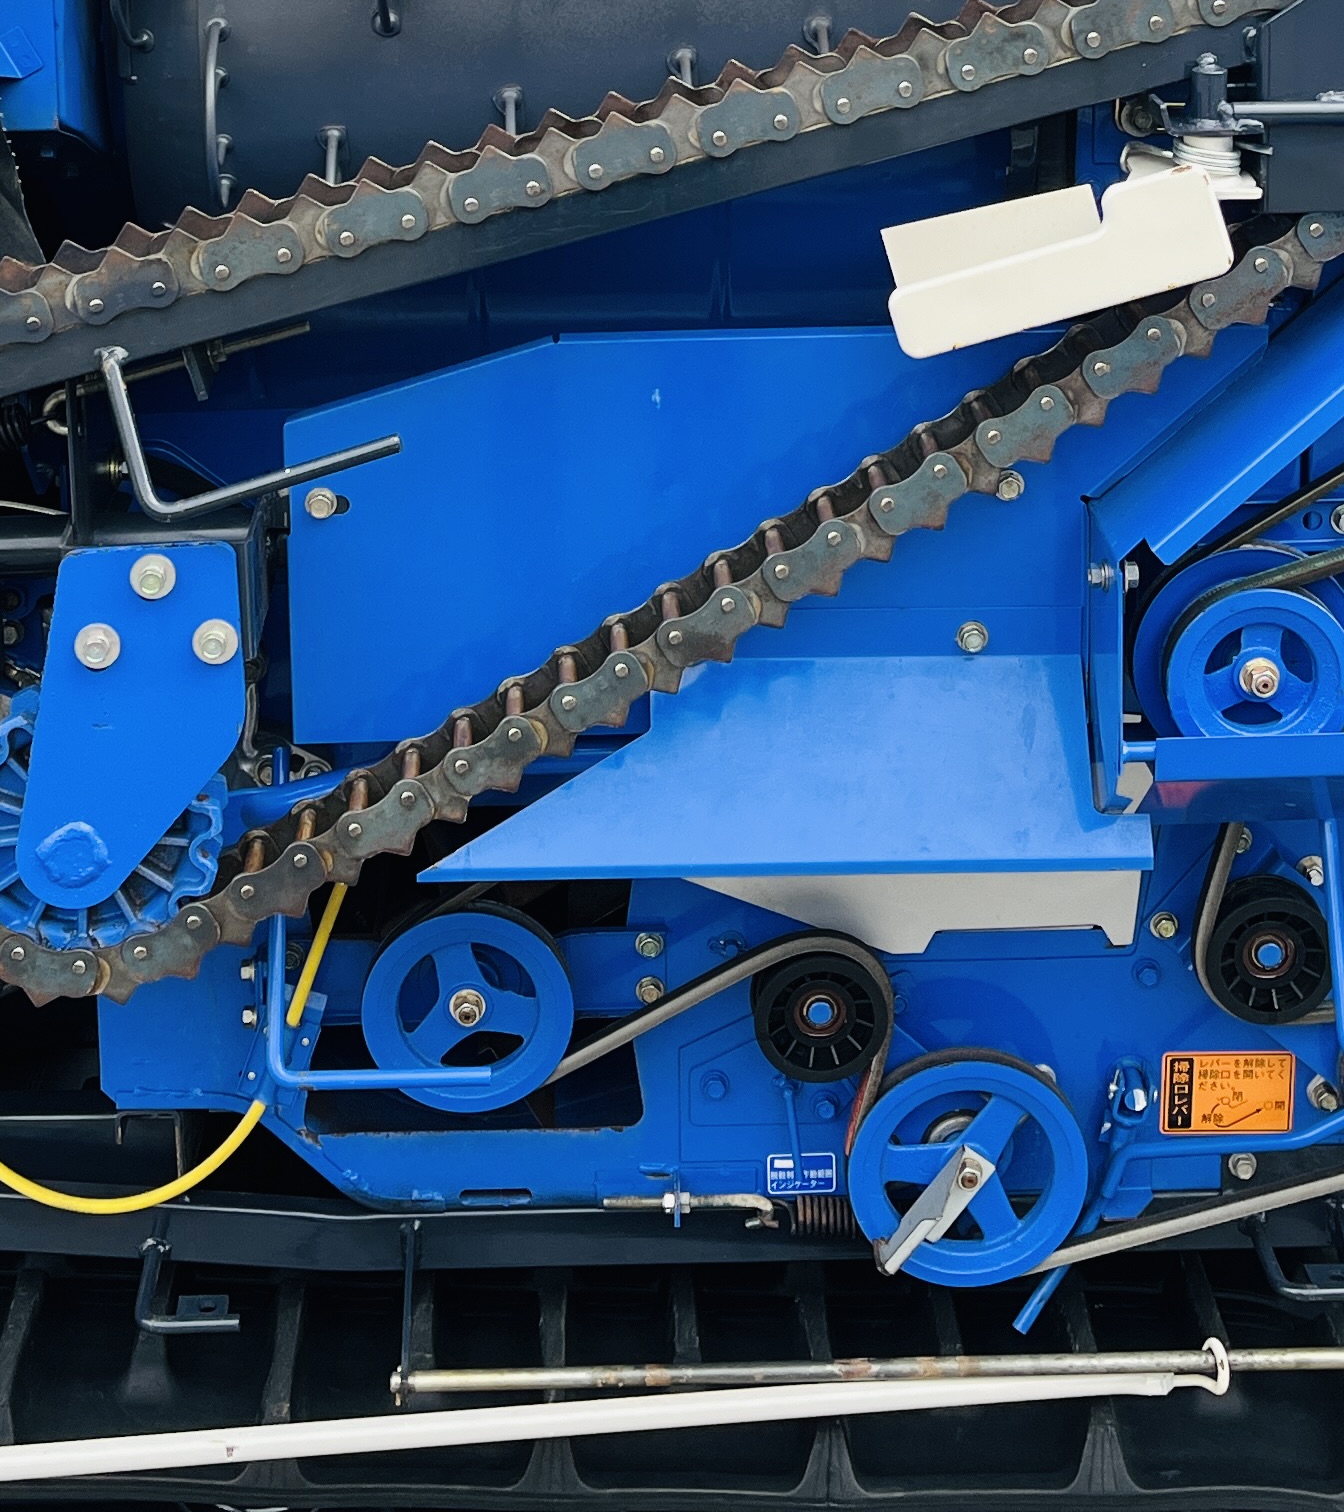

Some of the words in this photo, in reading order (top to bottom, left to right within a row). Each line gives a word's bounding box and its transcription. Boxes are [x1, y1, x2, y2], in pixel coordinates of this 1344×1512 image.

[1199, 1058, 1287, 1069] レバーを解除して
[1198, 1081, 1236, 1092] ださい。
[1171, 1060, 1190, 1126] 掃除口レバー
[1200, 1113, 1225, 1124] 解除
[771, 1179, 826, 1190] インジケーター
